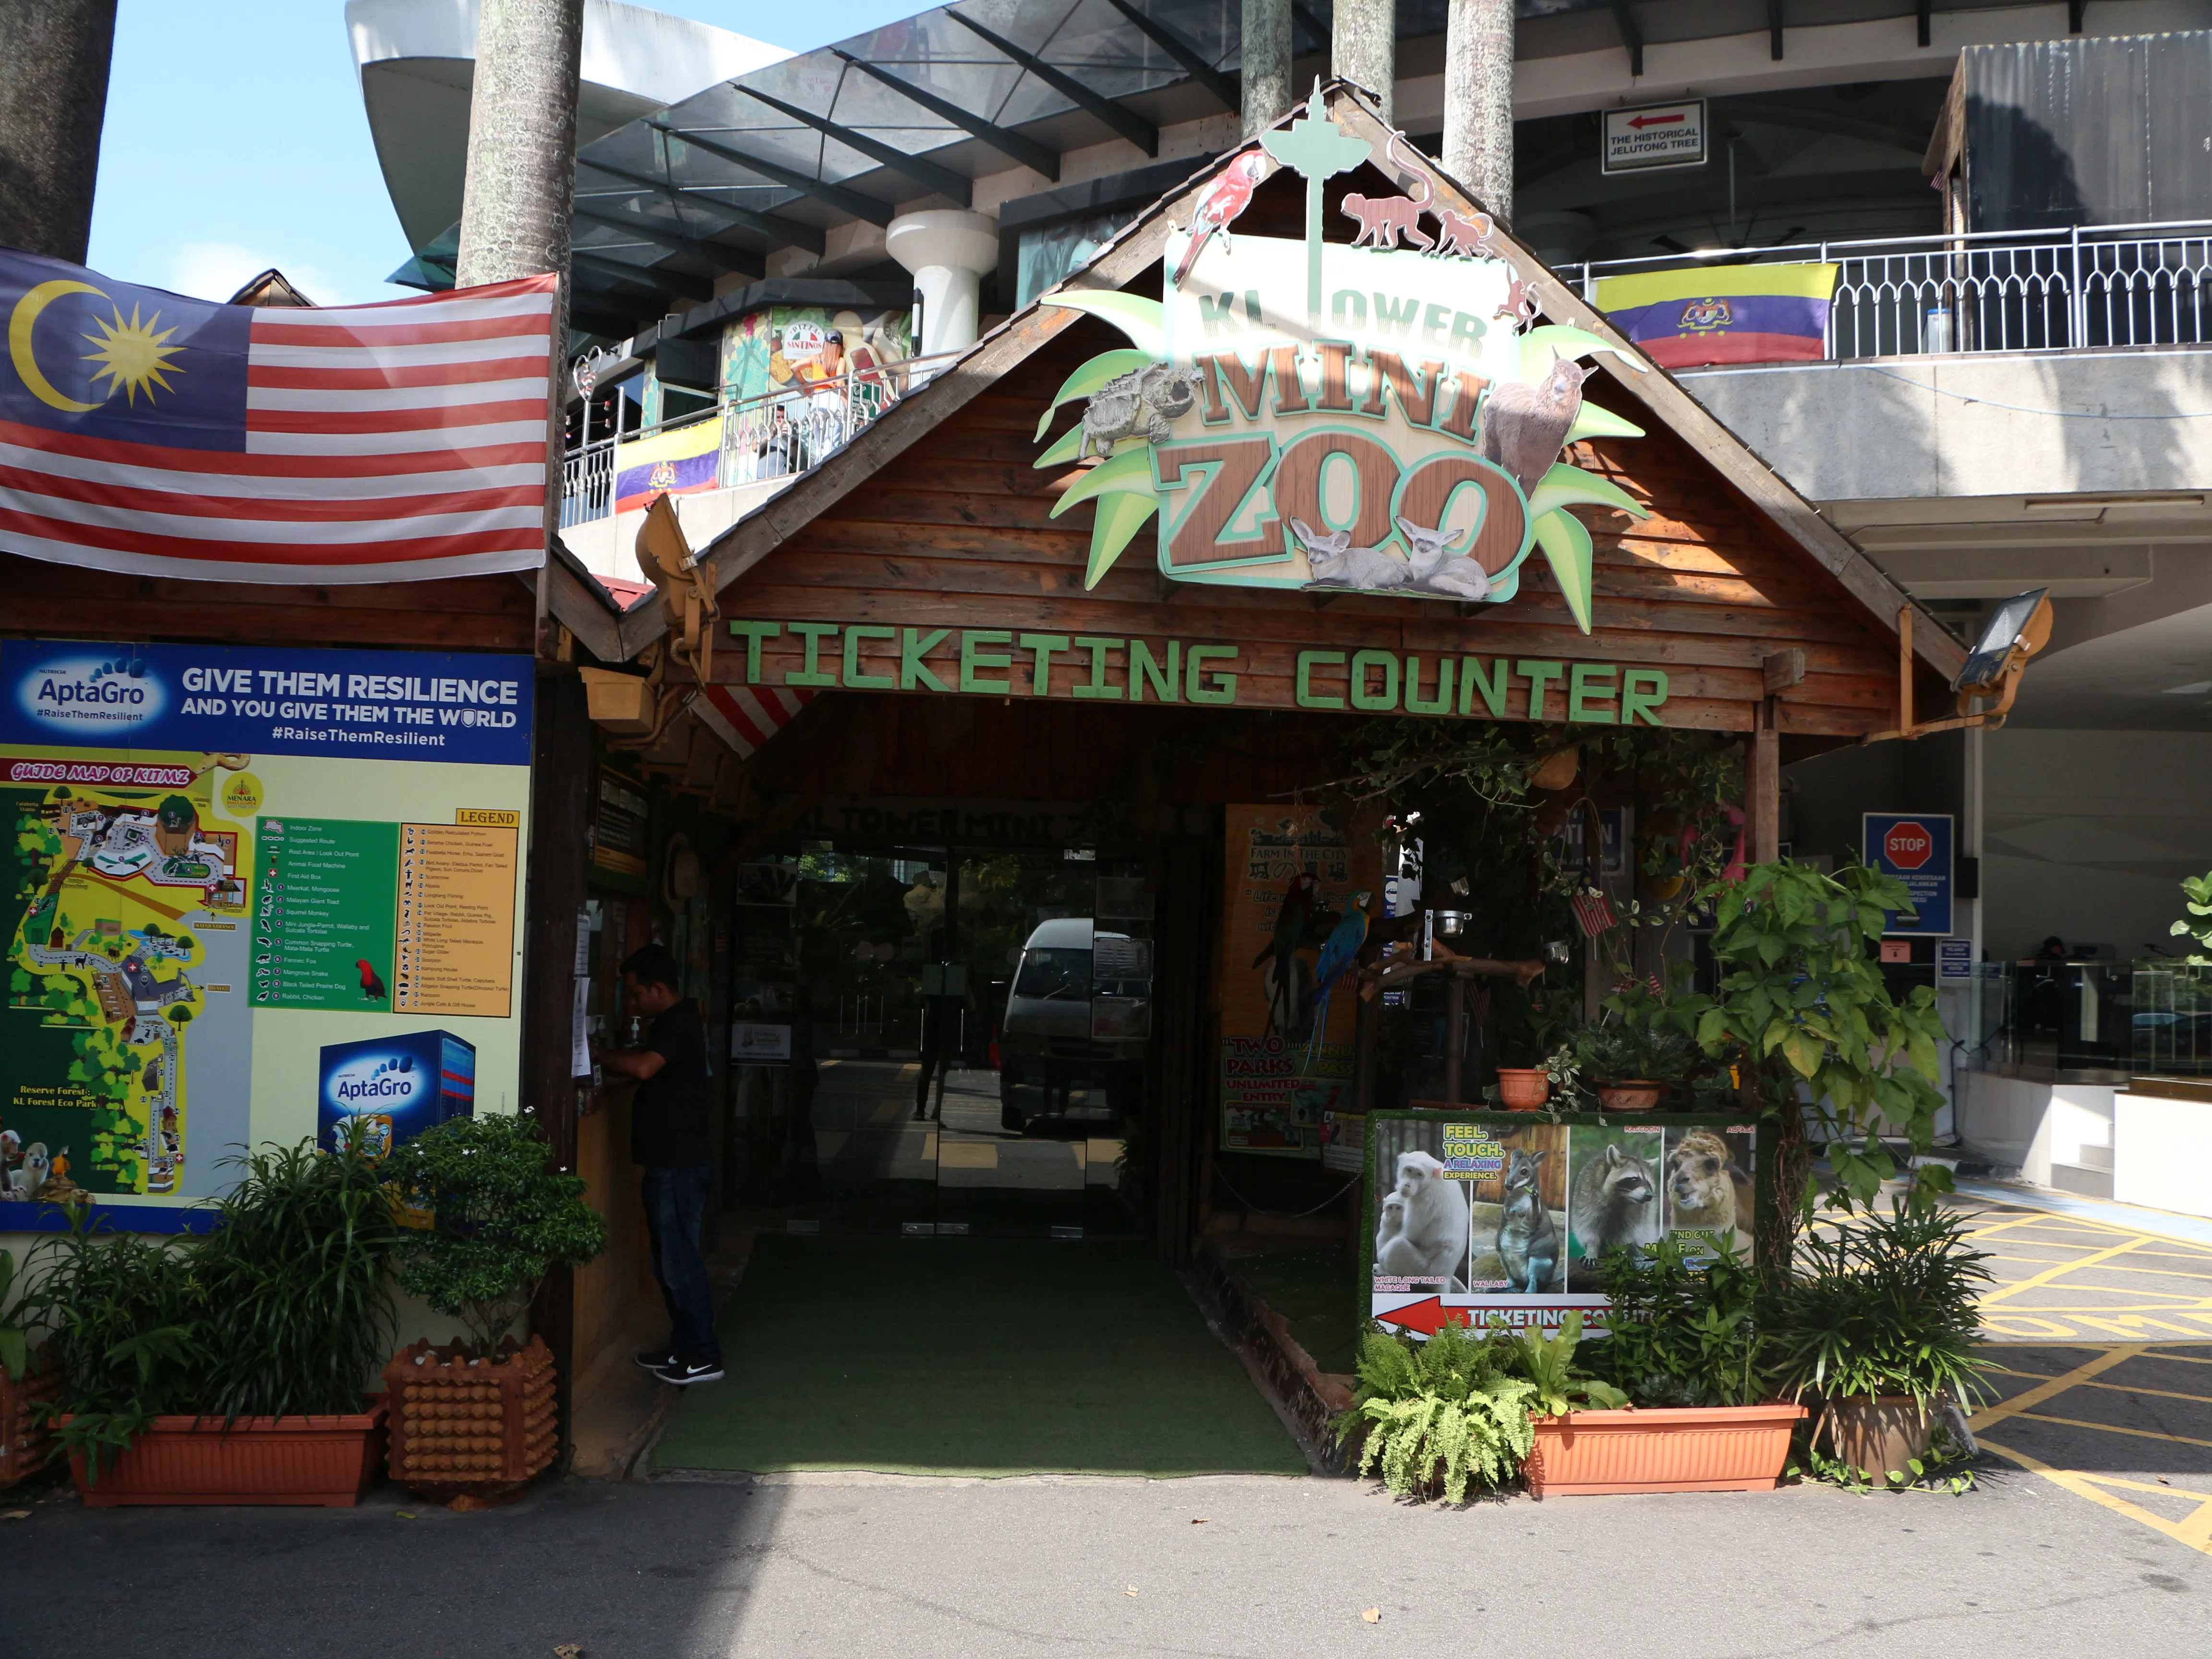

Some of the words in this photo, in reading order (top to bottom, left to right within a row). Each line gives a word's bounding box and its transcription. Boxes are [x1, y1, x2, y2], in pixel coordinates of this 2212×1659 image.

[1611, 135, 1631, 145] THE
[1634, 128, 1698, 143] HISTORICAL
[1611, 142, 1667, 155] JELUTONG
[1671, 138, 1698, 148] TREE
[1198, 289, 1276, 336] KL
[792, 324, 818, 333] PIZZA
[787, 341, 821, 349] SANTINOS
[1194, 338, 1495, 445] MINI
[1149, 426, 1532, 583] ZOO
[730, 621, 1238, 705] TICKETING
[1296, 649, 1669, 726] COUNTER
[38, 678, 144, 706] AptaGro
[182, 668, 251, 693] GIVE
[259, 671, 341, 697] THEM
[348, 674, 518, 705] RESILIENCE
[37, 709, 143, 721] #RaiseThemResilient
[181, 698, 226, 715] AND
[231, 700, 275, 717] YOU
[279, 702, 327, 720] GIVE
[333, 704, 388, 722] THEM
[393, 707, 433, 724] THE
[272, 727, 445, 746] #RaiseThemResilient
[11, 763, 65, 781] GUIDE
[67, 766, 109, 782] MAP
[111, 768, 133, 782] OF
[461, 811, 514, 824] LEGEND
[1889, 838, 1926, 851] STOP
[1251, 848, 1279, 859] FARM
[1298, 849, 1320, 859] THE
[1230, 1036, 1285, 1056] TWO
[1226, 1057, 1295, 1076] PARKS
[20, 1085, 55, 1094] Reserve
[57, 1087, 85, 1095] Forest
[337, 1078, 411, 1101] AptaGro
[1225, 1079, 1301, 1090] UNLIMITED
[27, 1098, 55, 1106] Forest
[1243, 1092, 1286, 1102] ENTRY
[1445, 1125, 1487, 1139] FEEL.
[1444, 1142, 1504, 1157] TOUCH.
[1443, 1159, 1453, 1169] A
[1453, 1159, 1502, 1169] RELAXING
[1443, 1171, 1498, 1180] EXPERIENCE.
[1374, 1284, 1410, 1292] MACAQUE
